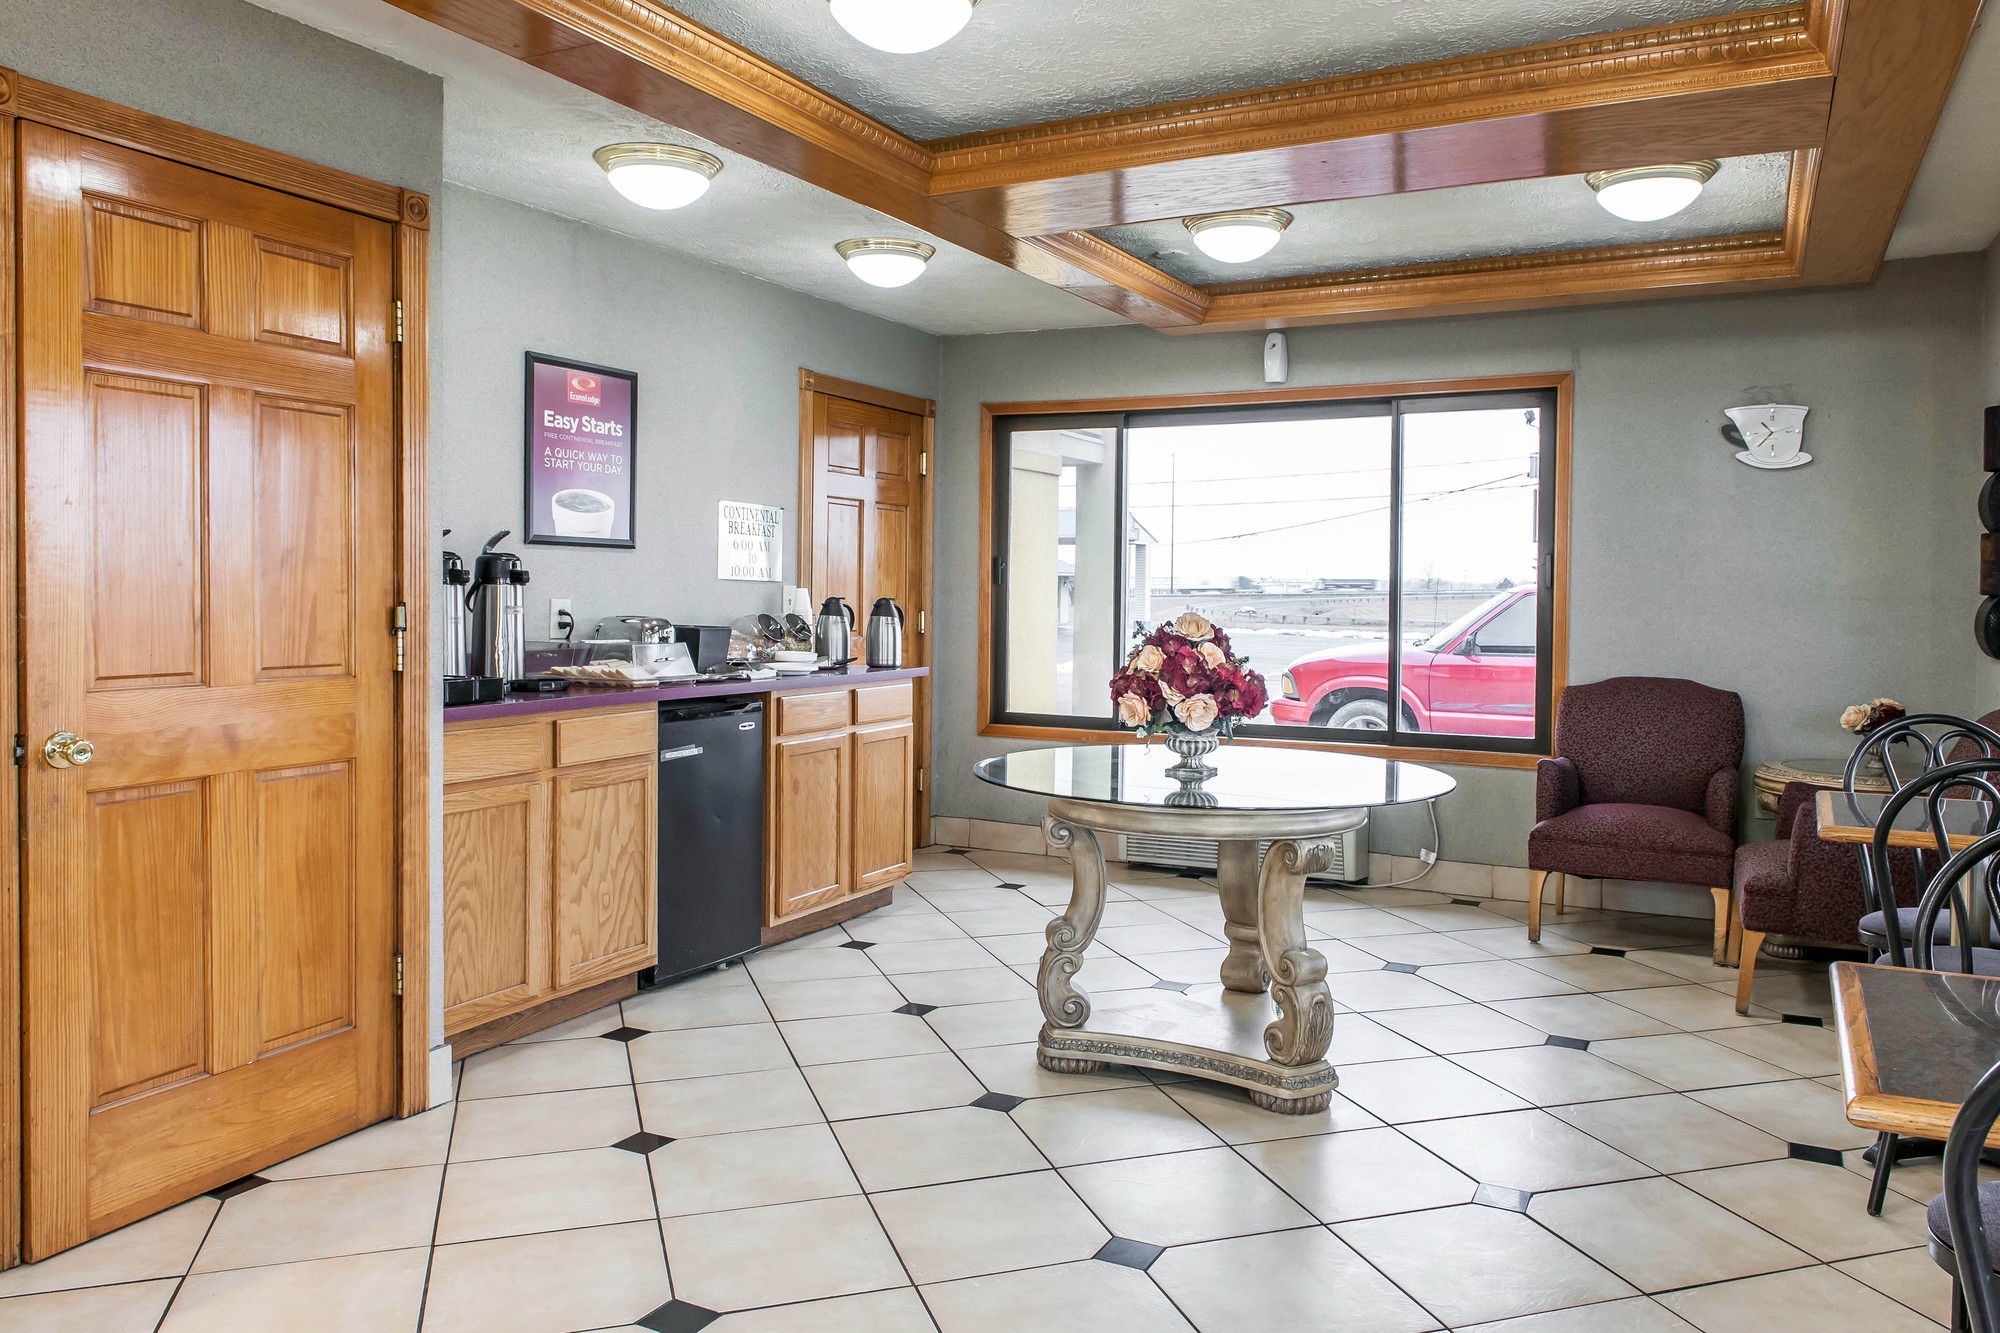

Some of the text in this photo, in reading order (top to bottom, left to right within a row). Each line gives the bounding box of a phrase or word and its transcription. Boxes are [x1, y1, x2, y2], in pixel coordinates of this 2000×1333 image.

[544, 409, 623, 437] Easy Starts
[544, 431, 623, 448] FREE CONTINENTAL BREAKFAST
[544, 446, 623, 465] A QUICK WAY TO
[544, 457, 624, 476] START YOUR DAY.
[723, 505, 780, 525] CONTINENTAL
[728, 520, 776, 538] BREAKFAST
[733, 540, 770, 552] 6:00 AM
[748, 553, 757, 564] TO
[730, 565, 772, 579] 10:00 AM
